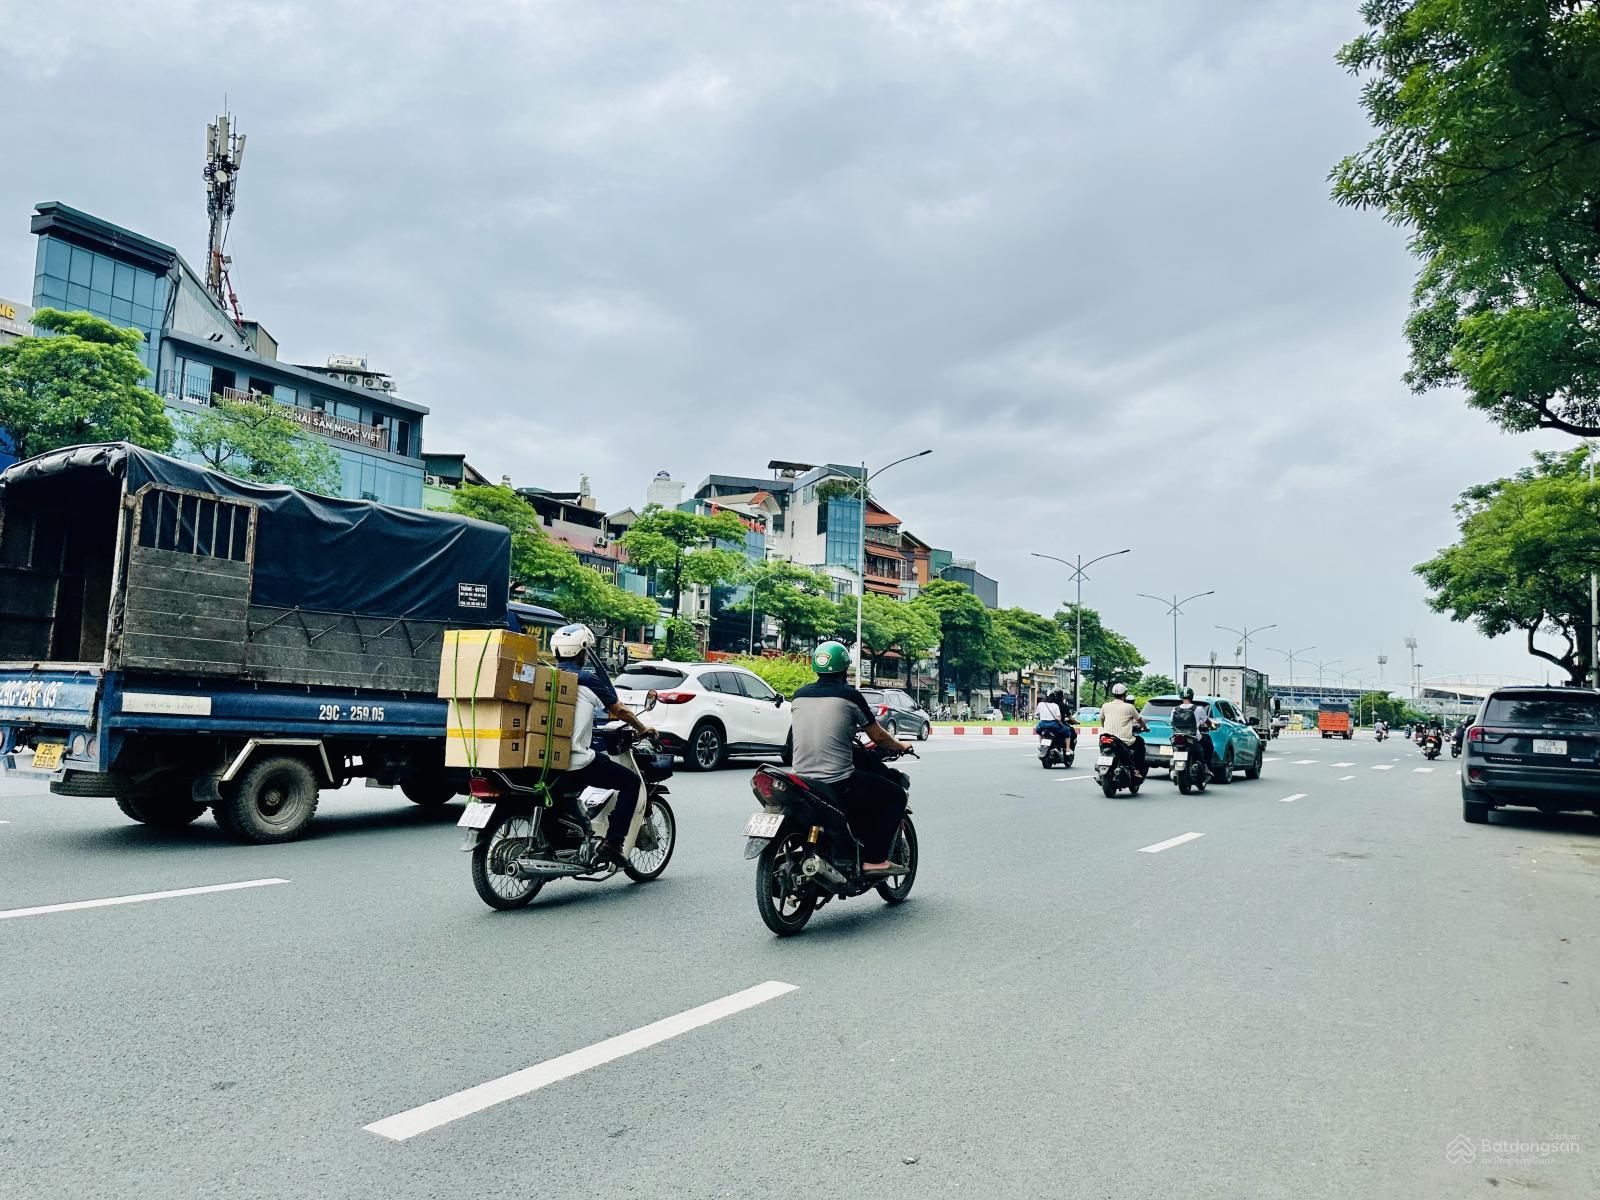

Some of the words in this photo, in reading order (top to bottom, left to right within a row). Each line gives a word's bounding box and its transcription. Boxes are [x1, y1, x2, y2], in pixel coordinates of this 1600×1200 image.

[334, 424, 360, 438] NGỌC
[361, 430, 381, 443] VIỆT
[319, 704, 340, 721] 29C
[350, 705, 385, 722] 259.05
